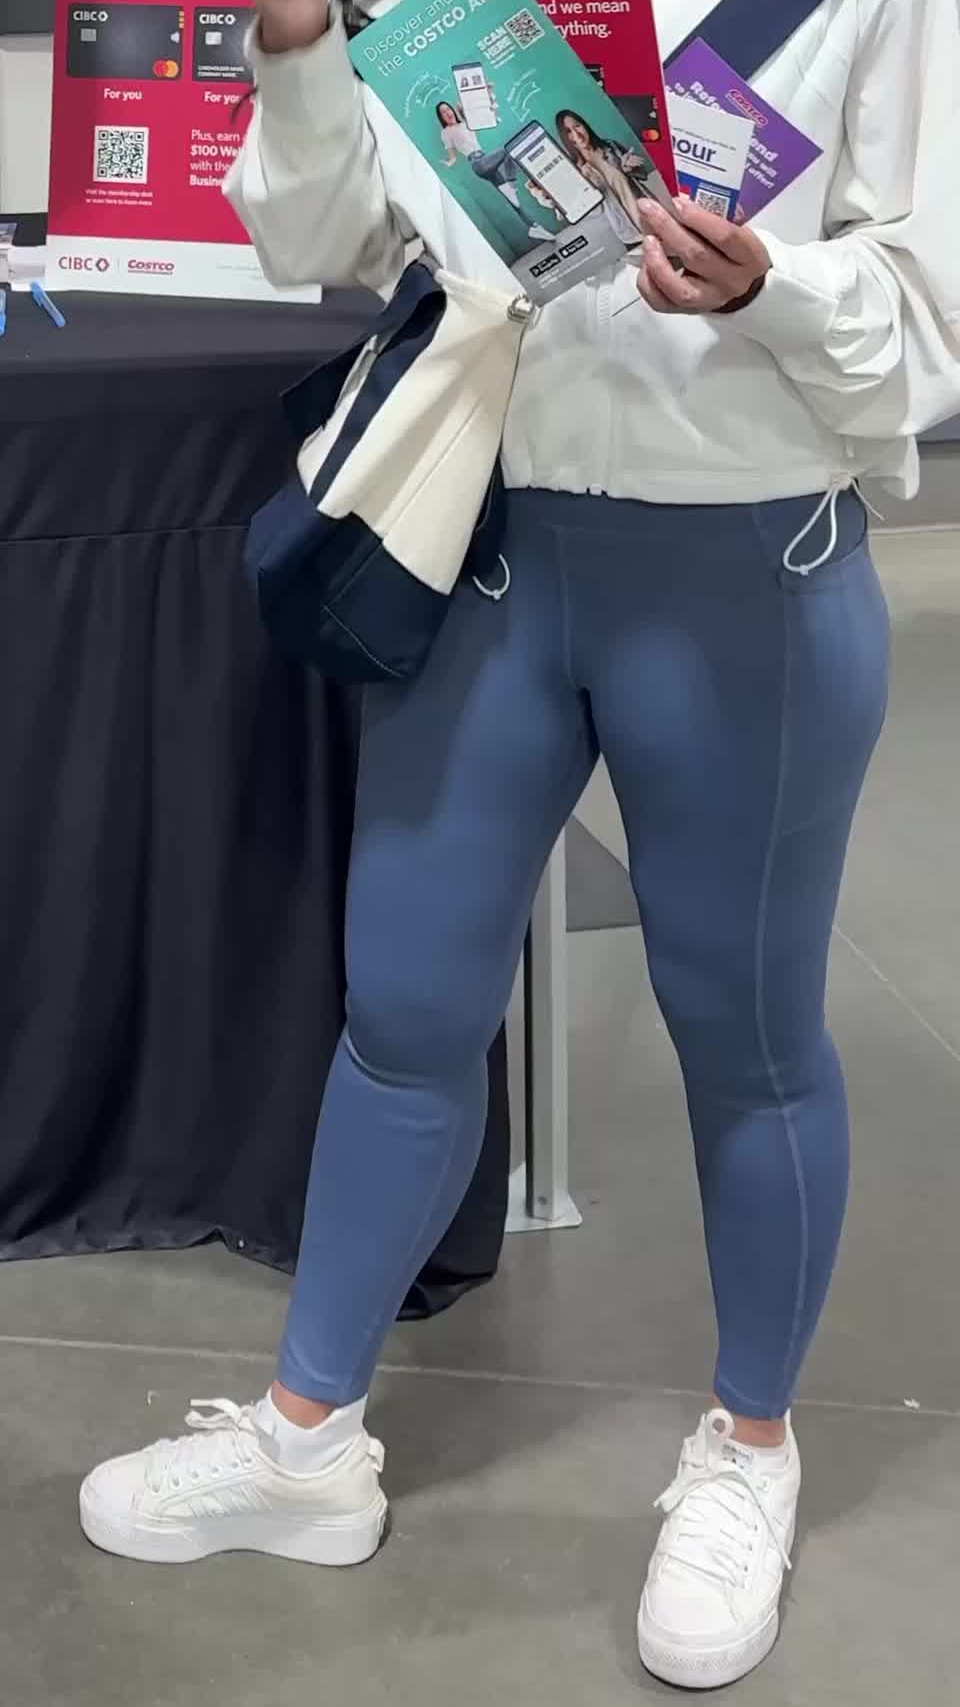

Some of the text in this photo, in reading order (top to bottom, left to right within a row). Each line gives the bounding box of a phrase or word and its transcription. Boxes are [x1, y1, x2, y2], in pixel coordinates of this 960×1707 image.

[559, 1, 584, 14] we
[585, 0, 631, 14] mean
[73, 10, 98, 21] CIBC
[199, 13, 225, 25] CIBC
[363, 12, 424, 63] Discover
[378, 54, 404, 78] the
[402, 5, 467, 58] COSTCO
[103, 88, 142, 102] For you
[204, 91, 222, 102] For
[191, 129, 240, 143] Plus, earn
[190, 144, 218, 157] $100
[671, 135, 717, 163] our
[190, 159, 212, 172] with
[58, 255, 93, 271] CIBC
[127, 259, 175, 272] COSTCO
